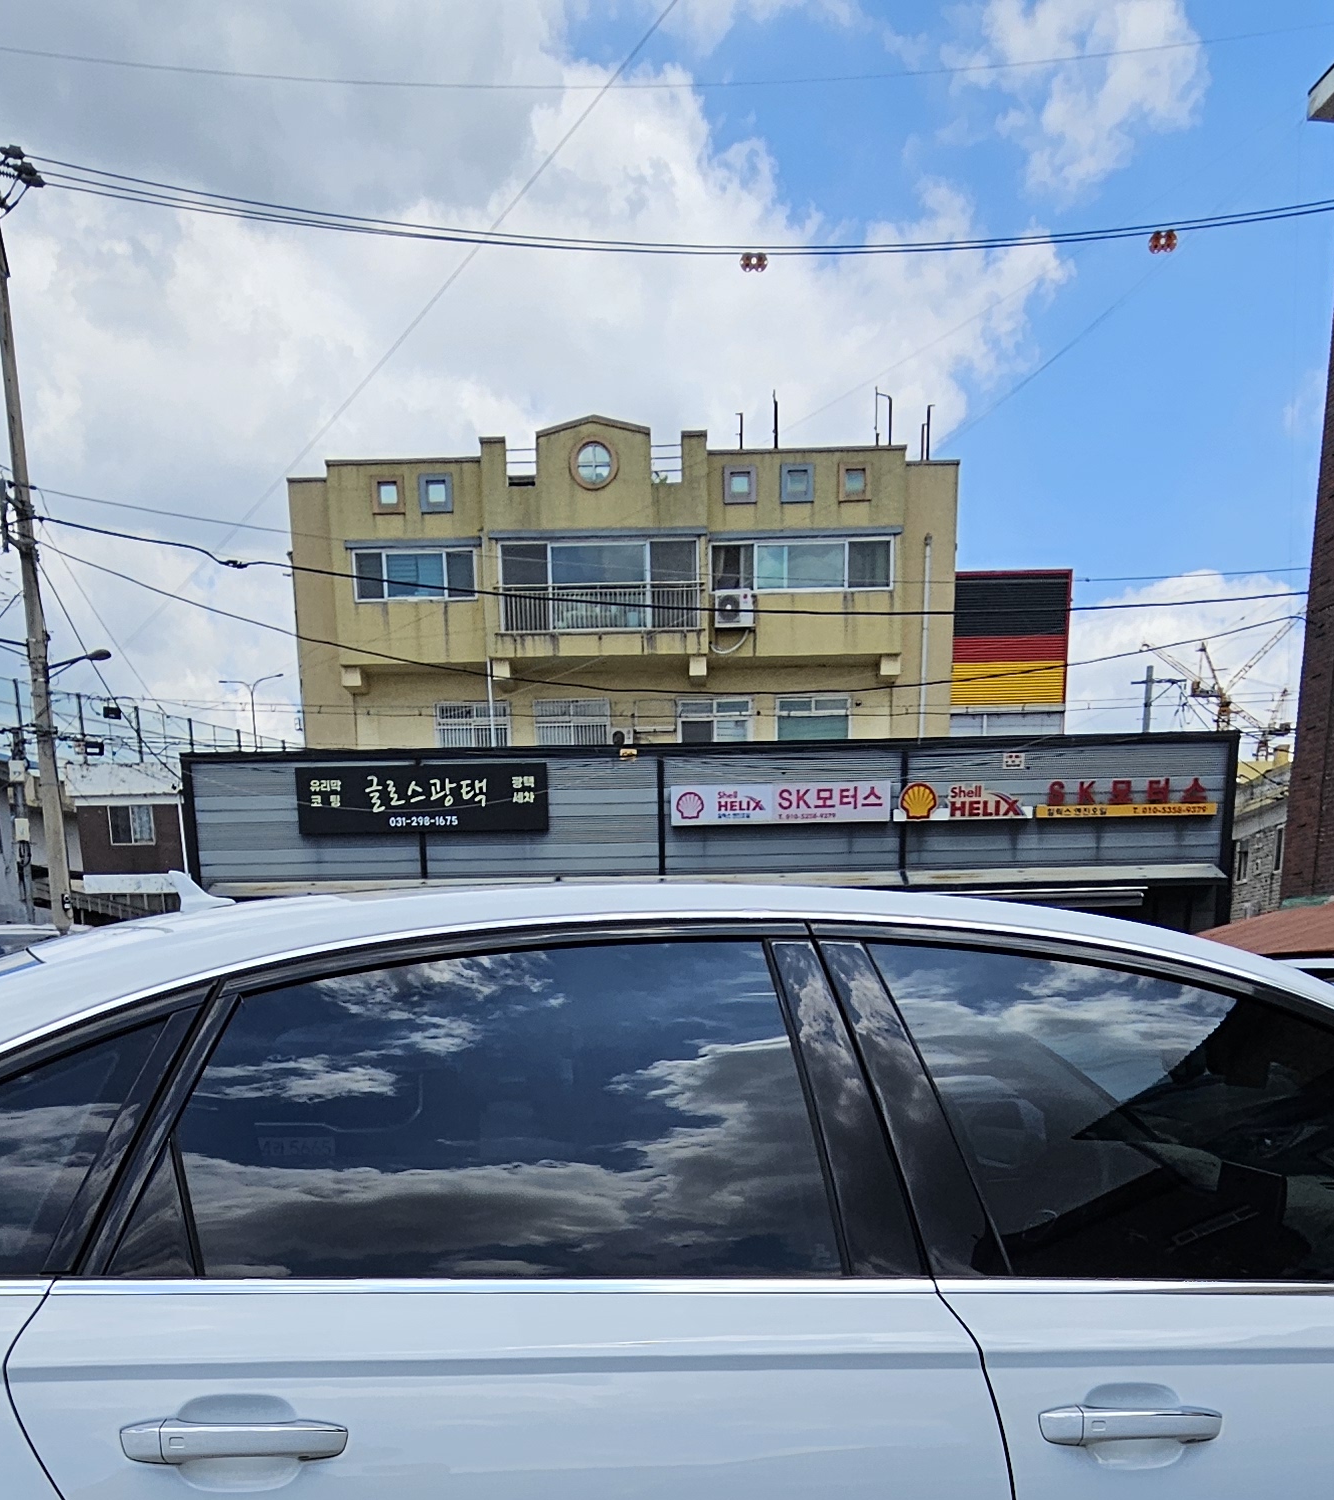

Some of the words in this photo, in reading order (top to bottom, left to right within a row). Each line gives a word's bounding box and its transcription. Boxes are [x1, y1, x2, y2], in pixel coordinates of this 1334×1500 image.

[310, 779, 341, 791] 유리막
[511, 776, 535, 789] 광택
[717, 790, 738, 799] Shell
[950, 784, 982, 798] Shell
[512, 792, 535, 804] 세차
[778, 786, 883, 810] SK모터스
[717, 799, 766, 812] HELIX
[950, 800, 1024, 817] HELIX
[389, 816, 458, 827] 031-298-1675
